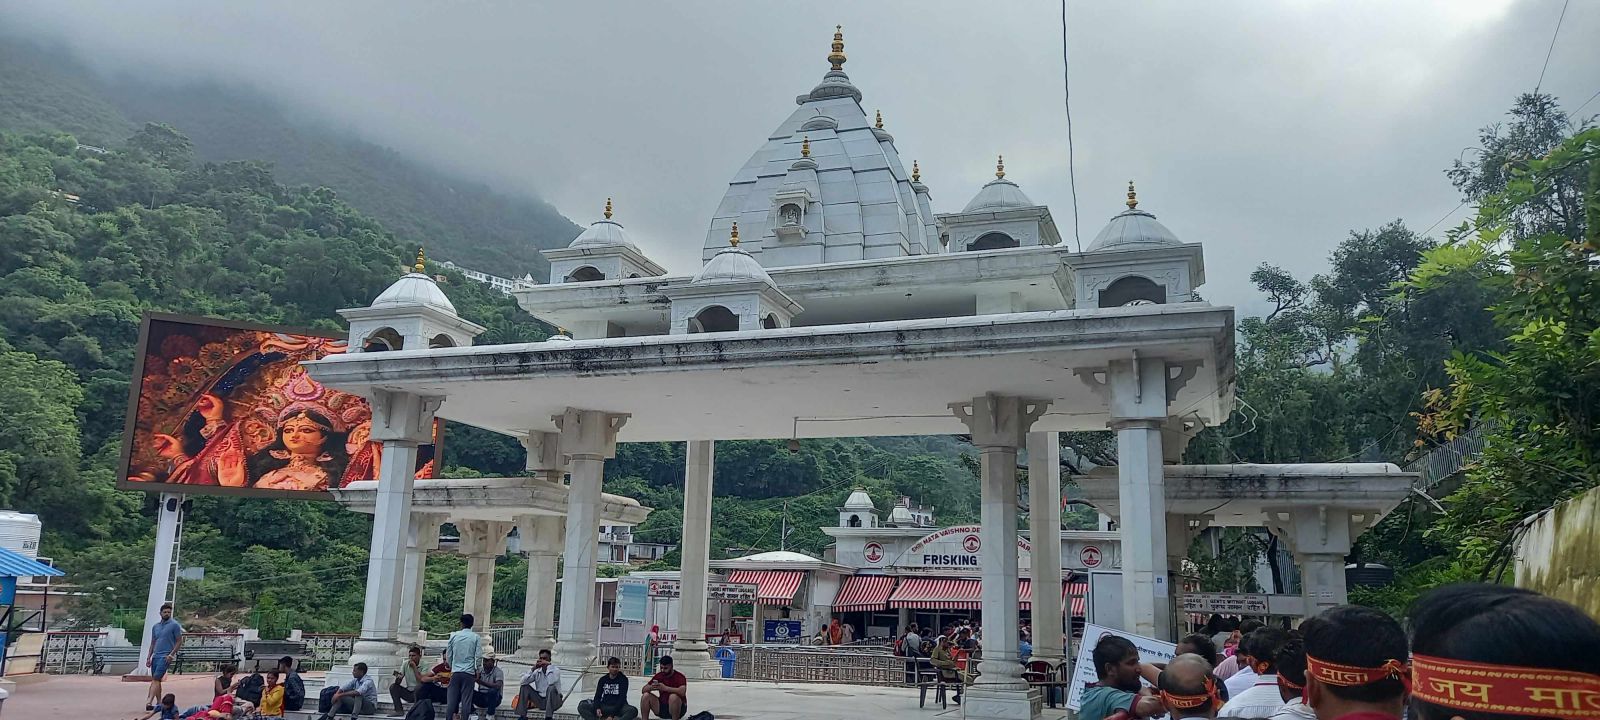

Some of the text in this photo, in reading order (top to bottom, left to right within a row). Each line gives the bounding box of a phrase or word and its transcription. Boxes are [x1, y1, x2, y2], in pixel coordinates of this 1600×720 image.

[922, 533, 940, 546] MATA
[939, 527, 969, 537] VAISHNO
[1017, 540, 1031, 551] OAR
[923, 554, 978, 566] FRISKING
[1321, 667, 1368, 682] माता
[1428, 676, 1493, 702] जय
